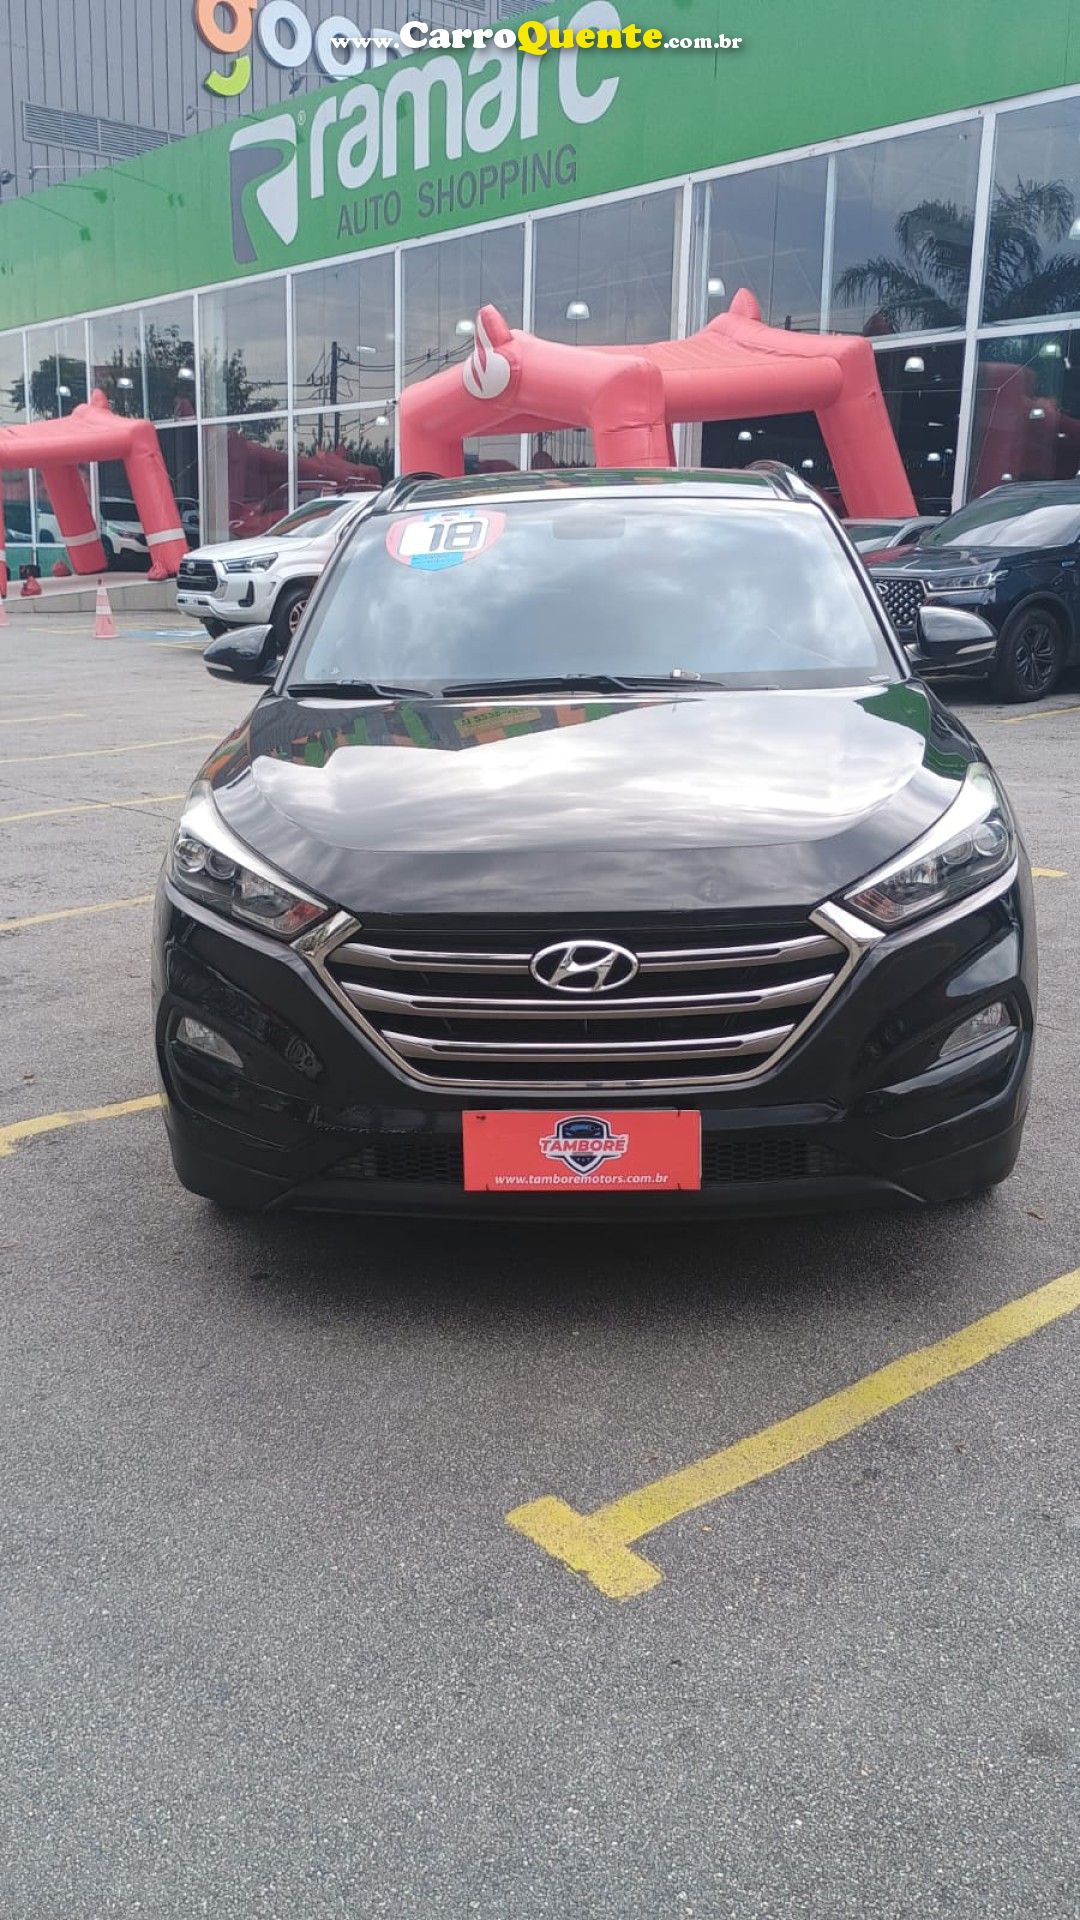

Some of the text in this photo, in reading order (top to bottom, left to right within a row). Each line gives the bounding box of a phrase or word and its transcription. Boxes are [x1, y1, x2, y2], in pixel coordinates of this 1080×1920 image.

[337, 144, 577, 239] AUTO SHOPPING
[540, 1136, 626, 1151] TAMBORÉ
[494, 1173, 669, 1184] www.tamboremotors.com.br
